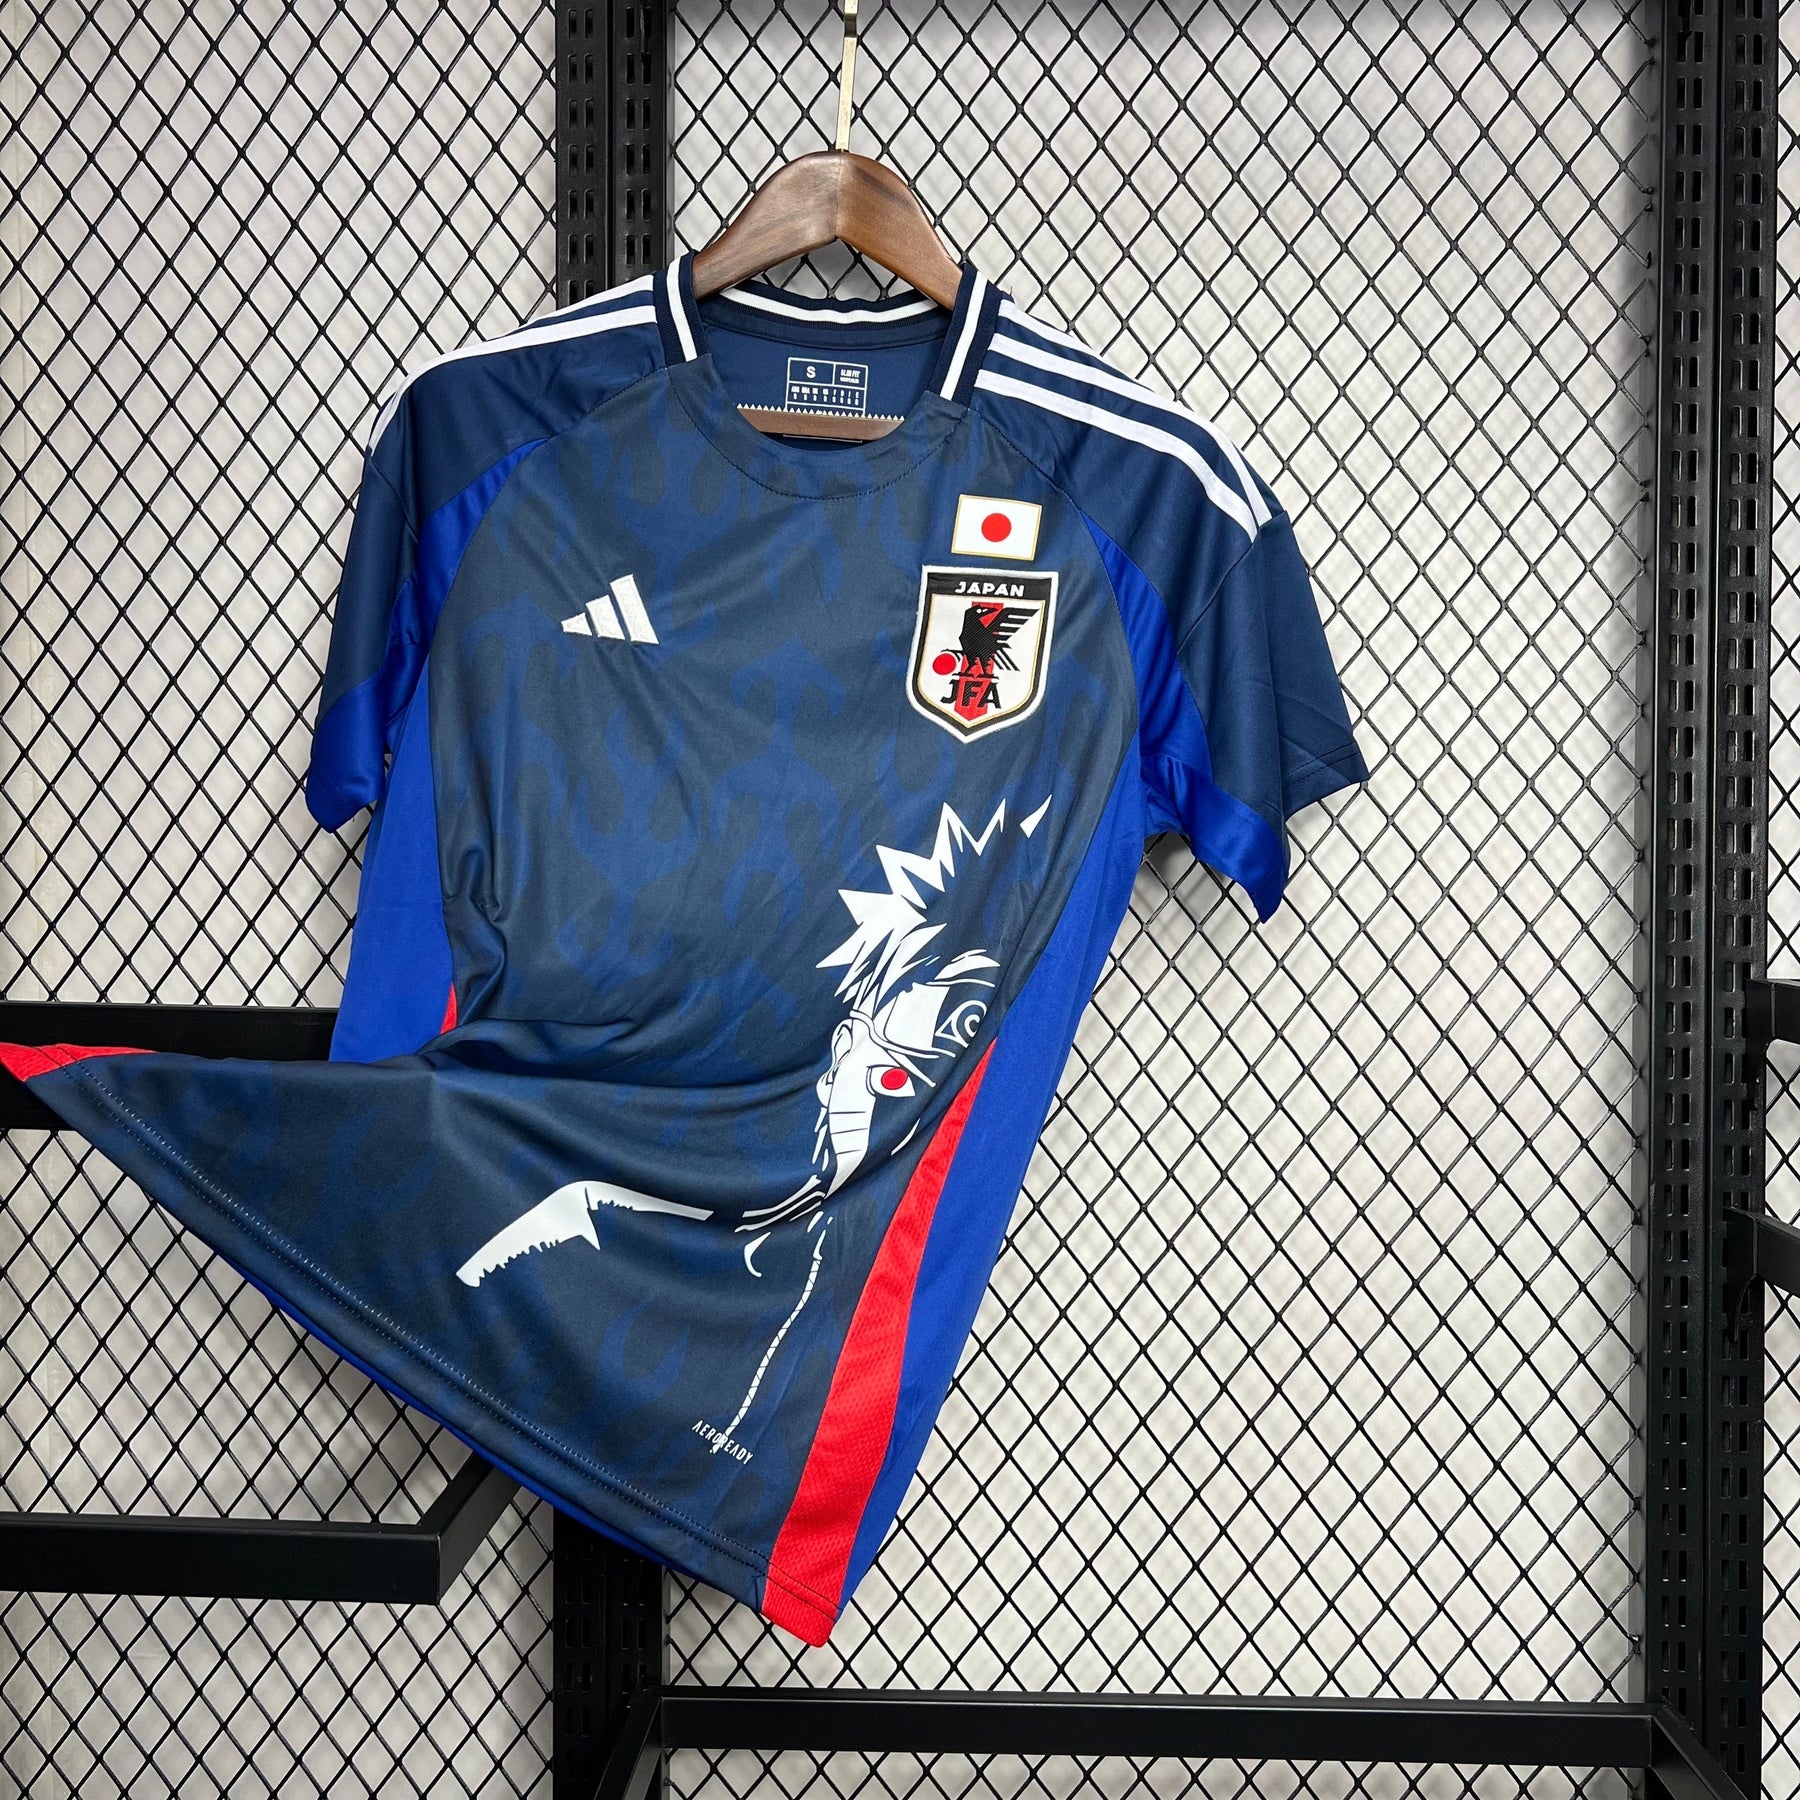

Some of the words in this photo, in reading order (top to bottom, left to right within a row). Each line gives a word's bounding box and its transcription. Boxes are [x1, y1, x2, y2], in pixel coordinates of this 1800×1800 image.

[806, 366, 816, 378] S
[954, 581, 1025, 597] JAPAN
[940, 679, 1002, 709] JFA
[691, 1419, 754, 1465] AEROREADY
